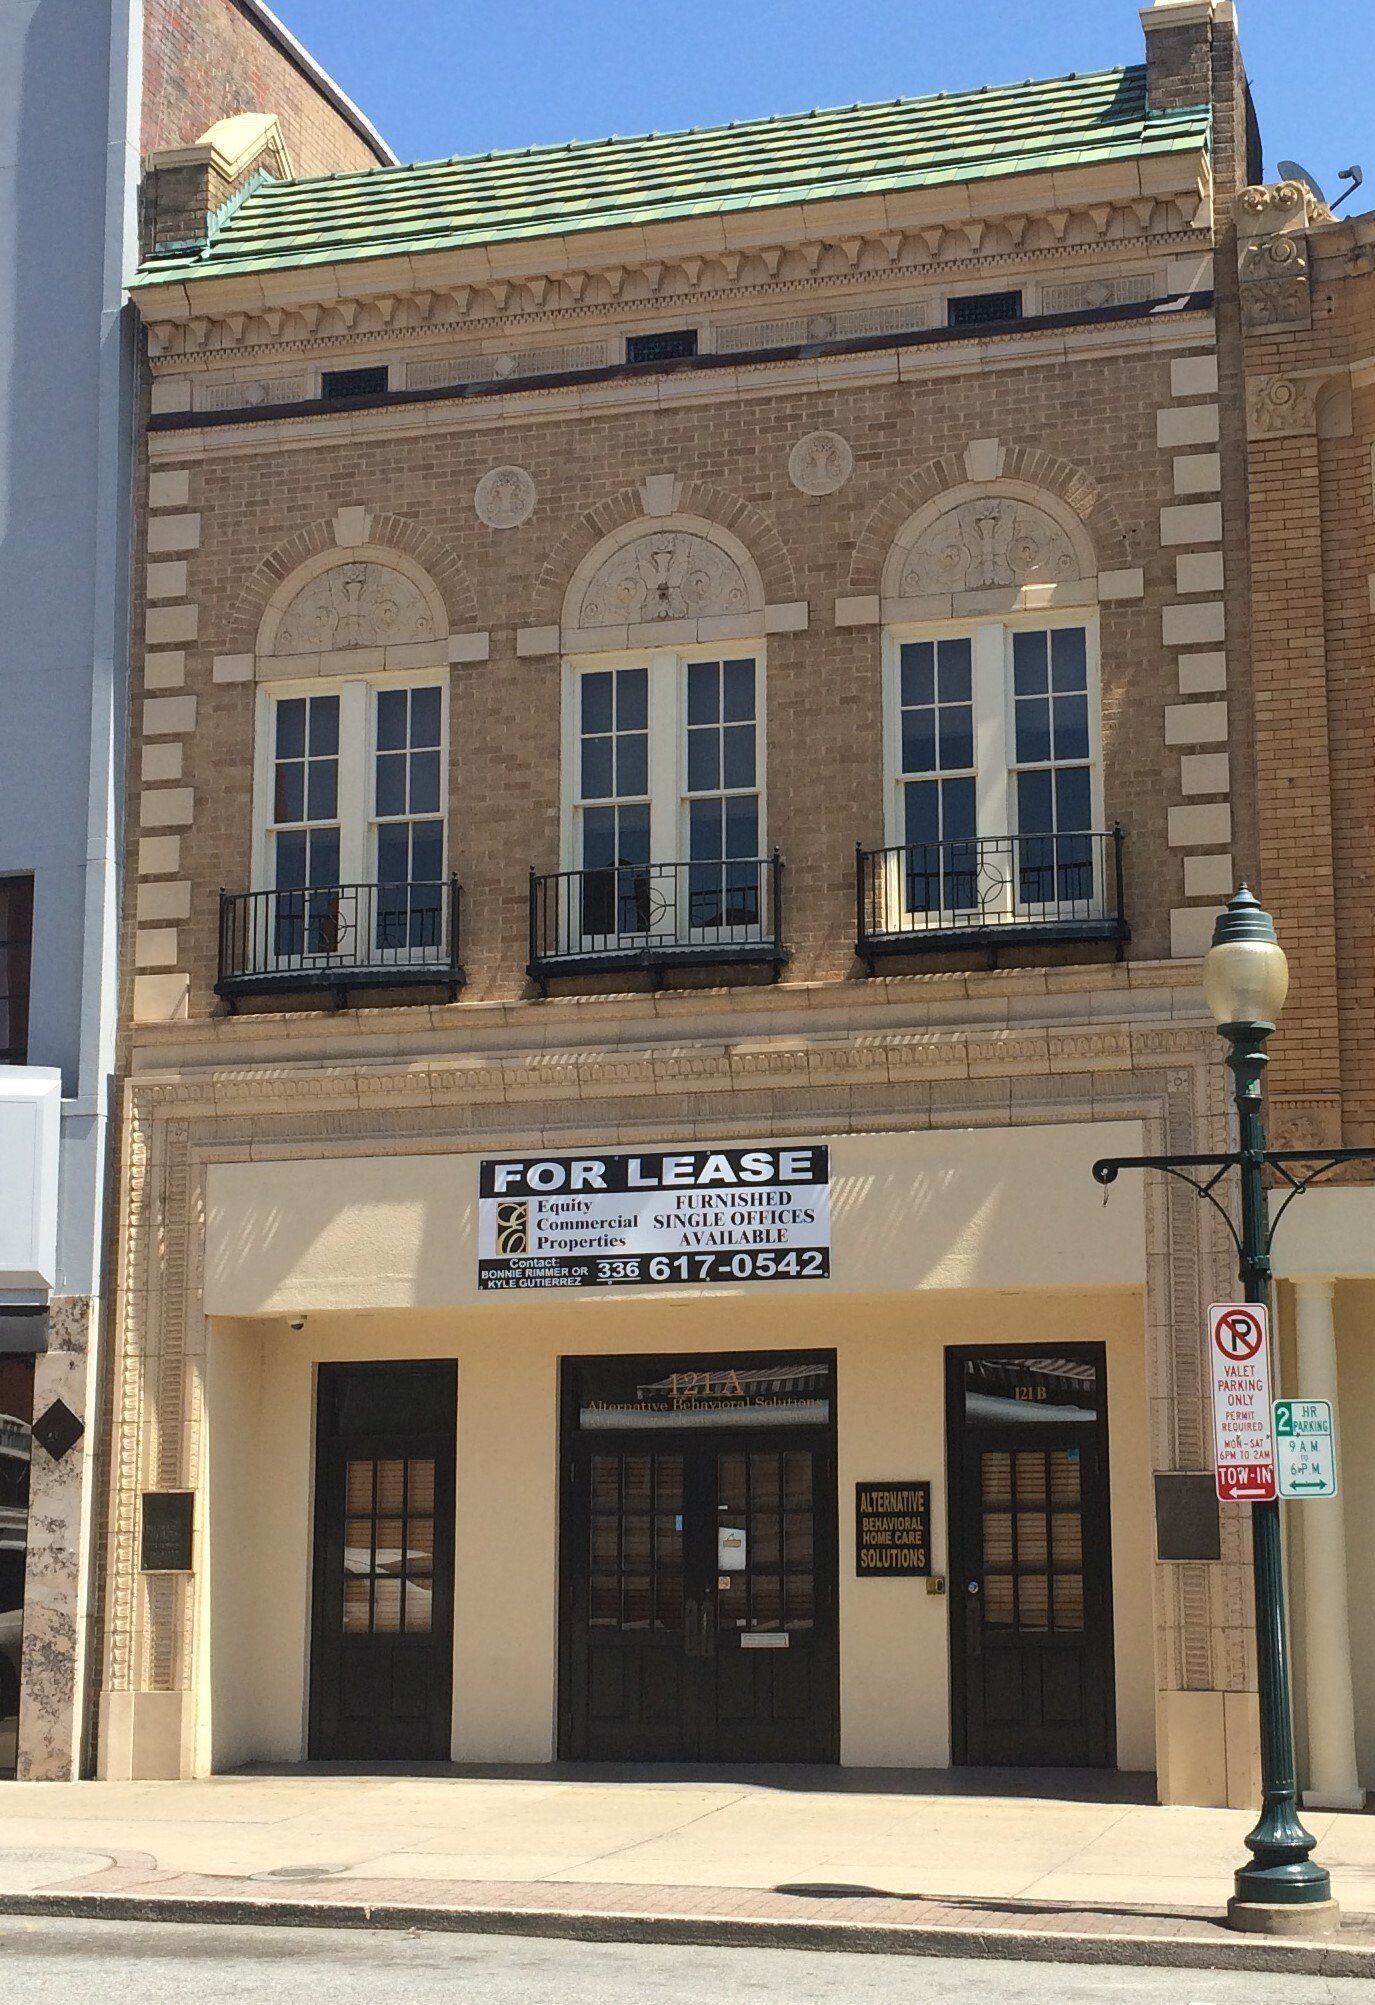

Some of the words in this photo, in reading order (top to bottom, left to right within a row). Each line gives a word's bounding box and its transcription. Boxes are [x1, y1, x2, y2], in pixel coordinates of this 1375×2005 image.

[494, 1160, 607, 1193] FOR
[627, 1151, 813, 1188] LEASE
[676, 1191, 792, 1209] FURNISHED
[537, 1199, 593, 1216] Equity
[537, 1215, 638, 1231] Commercial
[653, 1211, 725, 1229] SINGLE
[730, 1208, 815, 1227] OFFICES
[537, 1234, 627, 1251] Properties
[680, 1228, 788, 1246] AVAILABLE
[509, 1258, 560, 1268] Contact:
[597, 1261, 640, 1278] 336
[649, 1250, 824, 1281] 617-0542
[481, 1269, 523, 1279] BONNIE
[525, 1267, 569, 1278] RIMMER
[571, 1266, 589, 1276] OR
[488, 1279, 517, 1288] KYLE
[518, 1277, 582, 1288] GUTIERREZ
[1224, 1365, 1255, 1378] VALET
[1218, 1379, 1263, 1392] PARKING
[589, 1400, 668, 1411] Alternative
[673, 1397, 750, 1411] Behavioral
[755, 1396, 824, 1408] Solutions
[1227, 1394, 1254, 1406] ONLY
[1225, 1411, 1255, 1421] PERMIT
[1302, 1405, 1317, 1417] HR
[1277, 1407, 1290, 1431] 2
[1293, 1420, 1328, 1432] PARKING
[1222, 1422, 1263, 1432] REQUIRED
[1289, 1440, 1295, 1452] 9
[1240, 1450, 1249, 1459] TO
[1253, 1450, 1270, 1459] 2AM
[1218, 1466, 1272, 1485] TOW-IN
[1290, 1463, 1297, 1475] 6
[860, 1490, 925, 1512] ALTERNATIVE
[862, 1517, 923, 1531] BEHAVIORAL
[863, 1531, 893, 1545] HOME
[894, 1531, 922, 1545] CARE
[860, 1548, 926, 1568] SOLUTIONS
